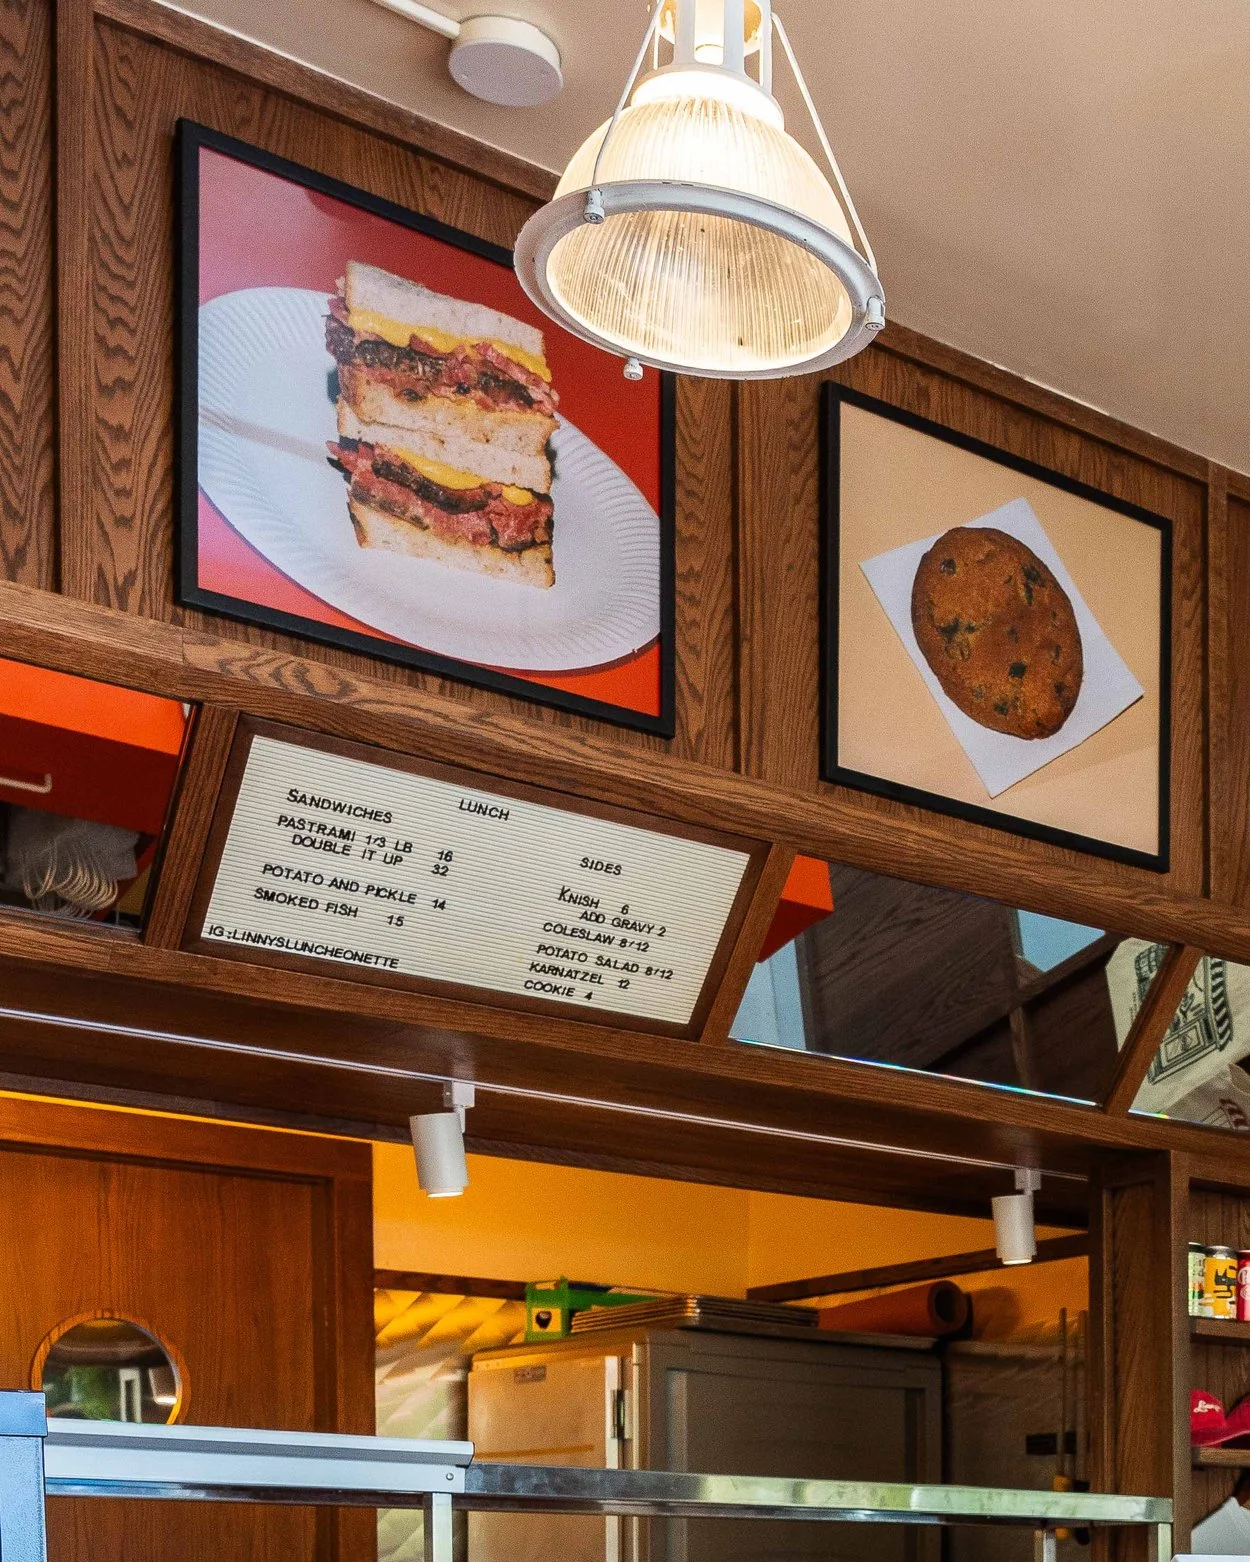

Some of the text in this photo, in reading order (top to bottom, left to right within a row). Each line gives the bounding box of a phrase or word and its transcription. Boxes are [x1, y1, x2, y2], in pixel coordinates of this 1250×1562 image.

[286, 788, 393, 824] SANDWICHES
[458, 798, 510, 821] LUNCH
[277, 814, 453, 863] PASTRAMI 1/3 LB 16
[292, 834, 449, 877] DOUBLE IT UP 32
[579, 856, 623, 876] SIDES
[261, 864, 447, 911] POTATO AND PICKLE 14
[558, 885, 630, 915] KNISH 6
[253, 887, 404, 927] SMOKED FISH 15
[542, 922, 650, 953] COLESLAW 8/12
[579, 910, 667, 938] ADD GRAVY 2
[528, 962, 630, 990] KARNATZEL 12
[536, 944, 674, 980] POTATO SALAD 8/12
[523, 979, 593, 1001] COOKIE 4
